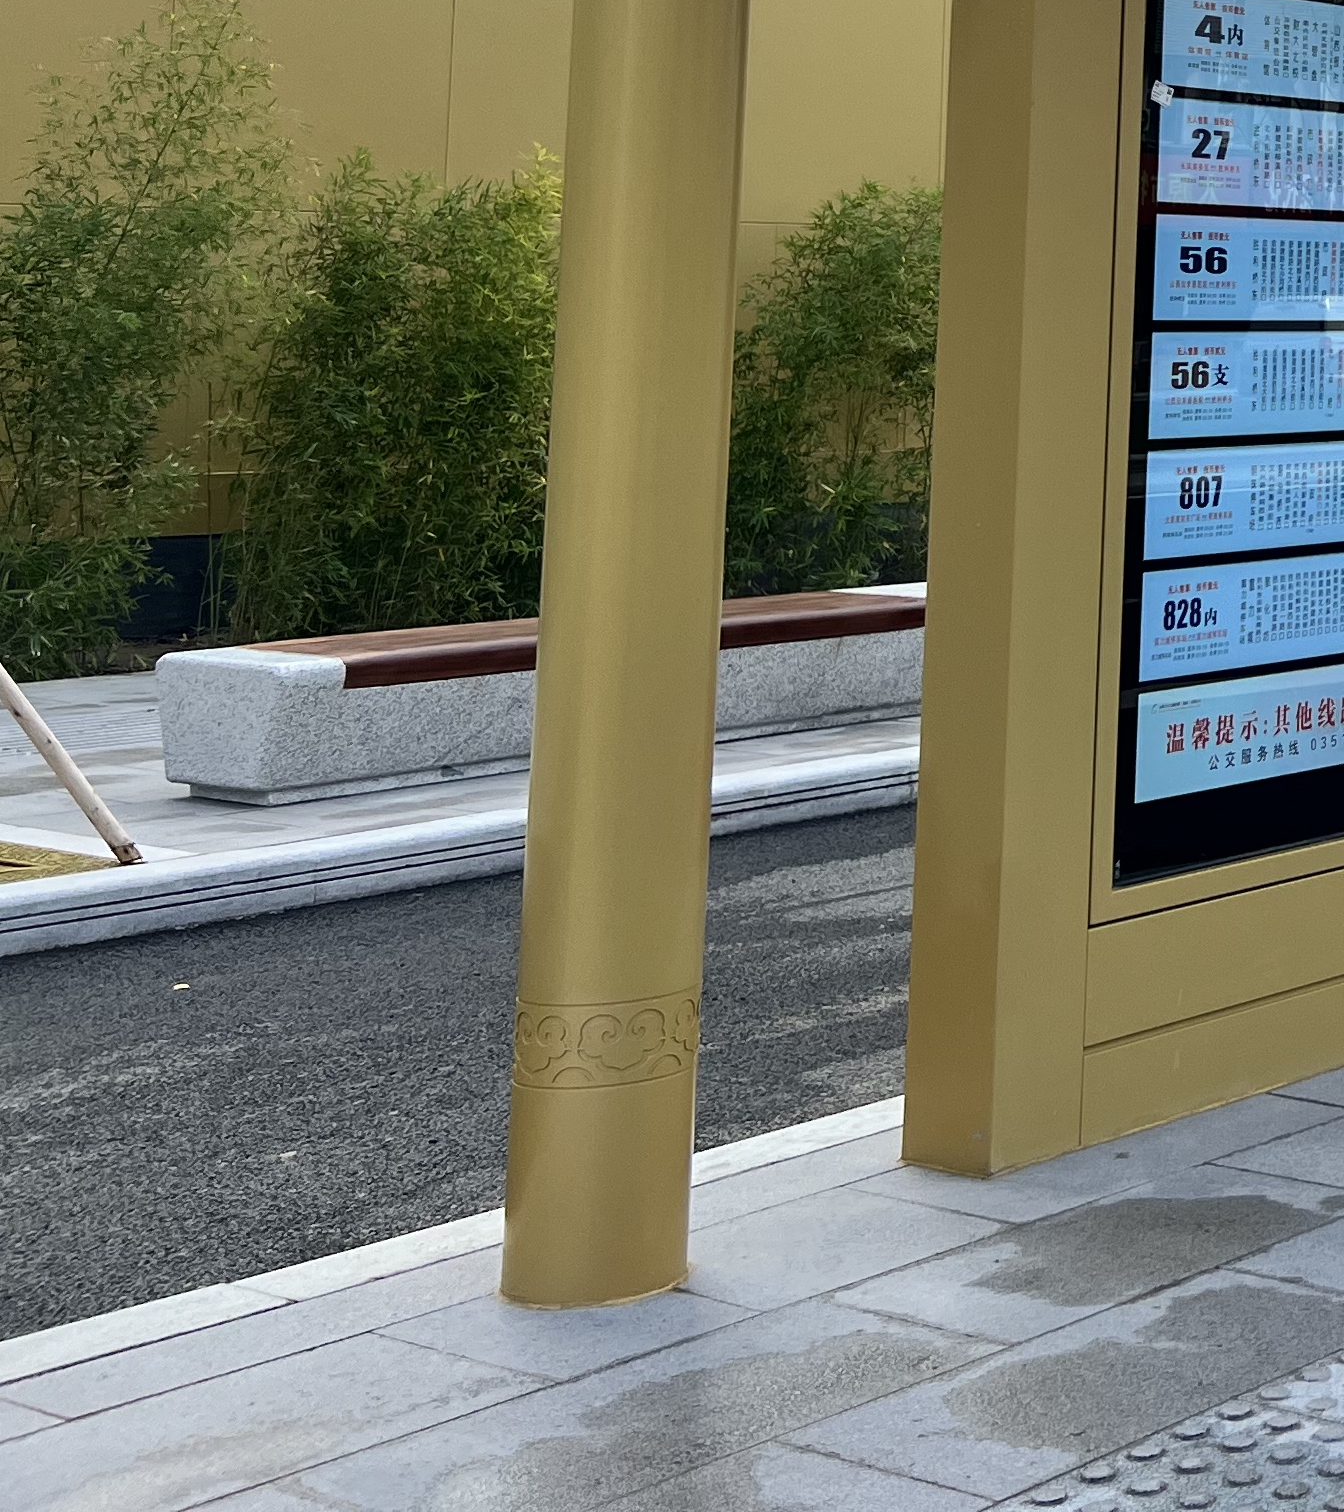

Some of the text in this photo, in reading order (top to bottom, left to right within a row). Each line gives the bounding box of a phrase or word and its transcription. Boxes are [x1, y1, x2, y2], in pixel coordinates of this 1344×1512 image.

[1191, 128, 1230, 160] 27
[1179, 246, 1228, 274] 56
[1179, 476, 1223, 510] 807
[1208, 740, 1299, 770] 公交服务热线
